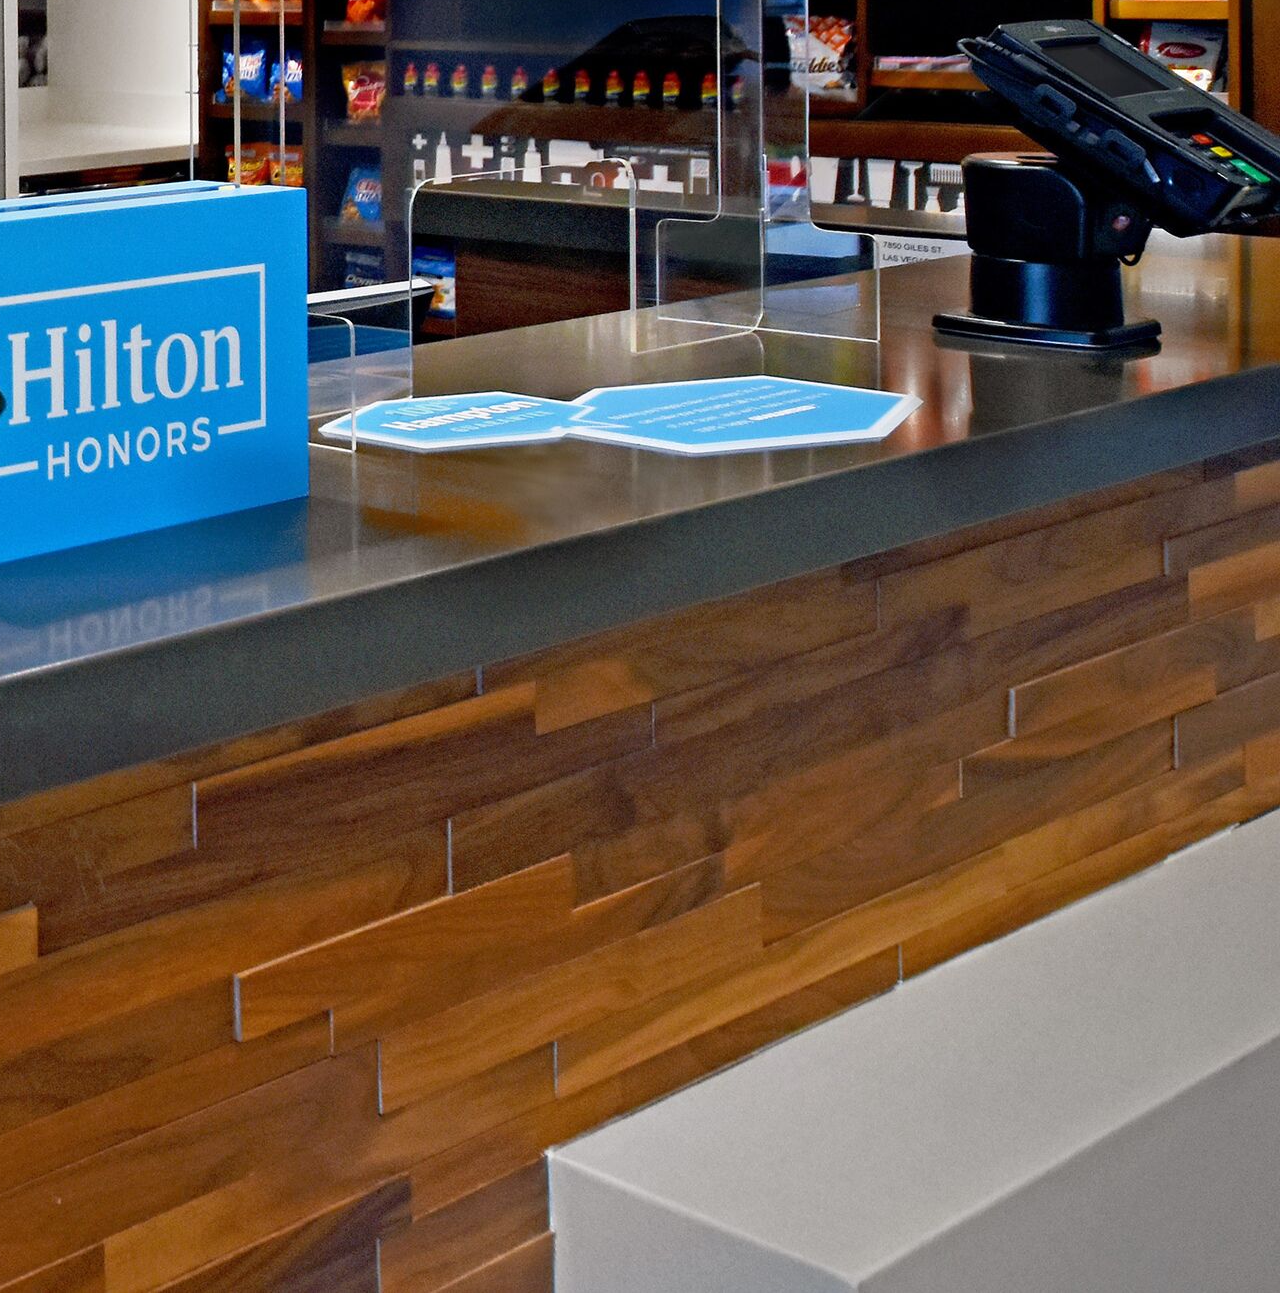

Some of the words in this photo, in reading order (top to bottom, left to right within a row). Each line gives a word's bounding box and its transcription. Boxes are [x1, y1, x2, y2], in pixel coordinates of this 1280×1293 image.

[882, 253, 898, 262] LAS
[903, 243, 929, 252] GILES
[8, 319, 244, 425] Hilton
[380, 400, 542, 431] Hampton
[47, 416, 213, 481] HONORS
